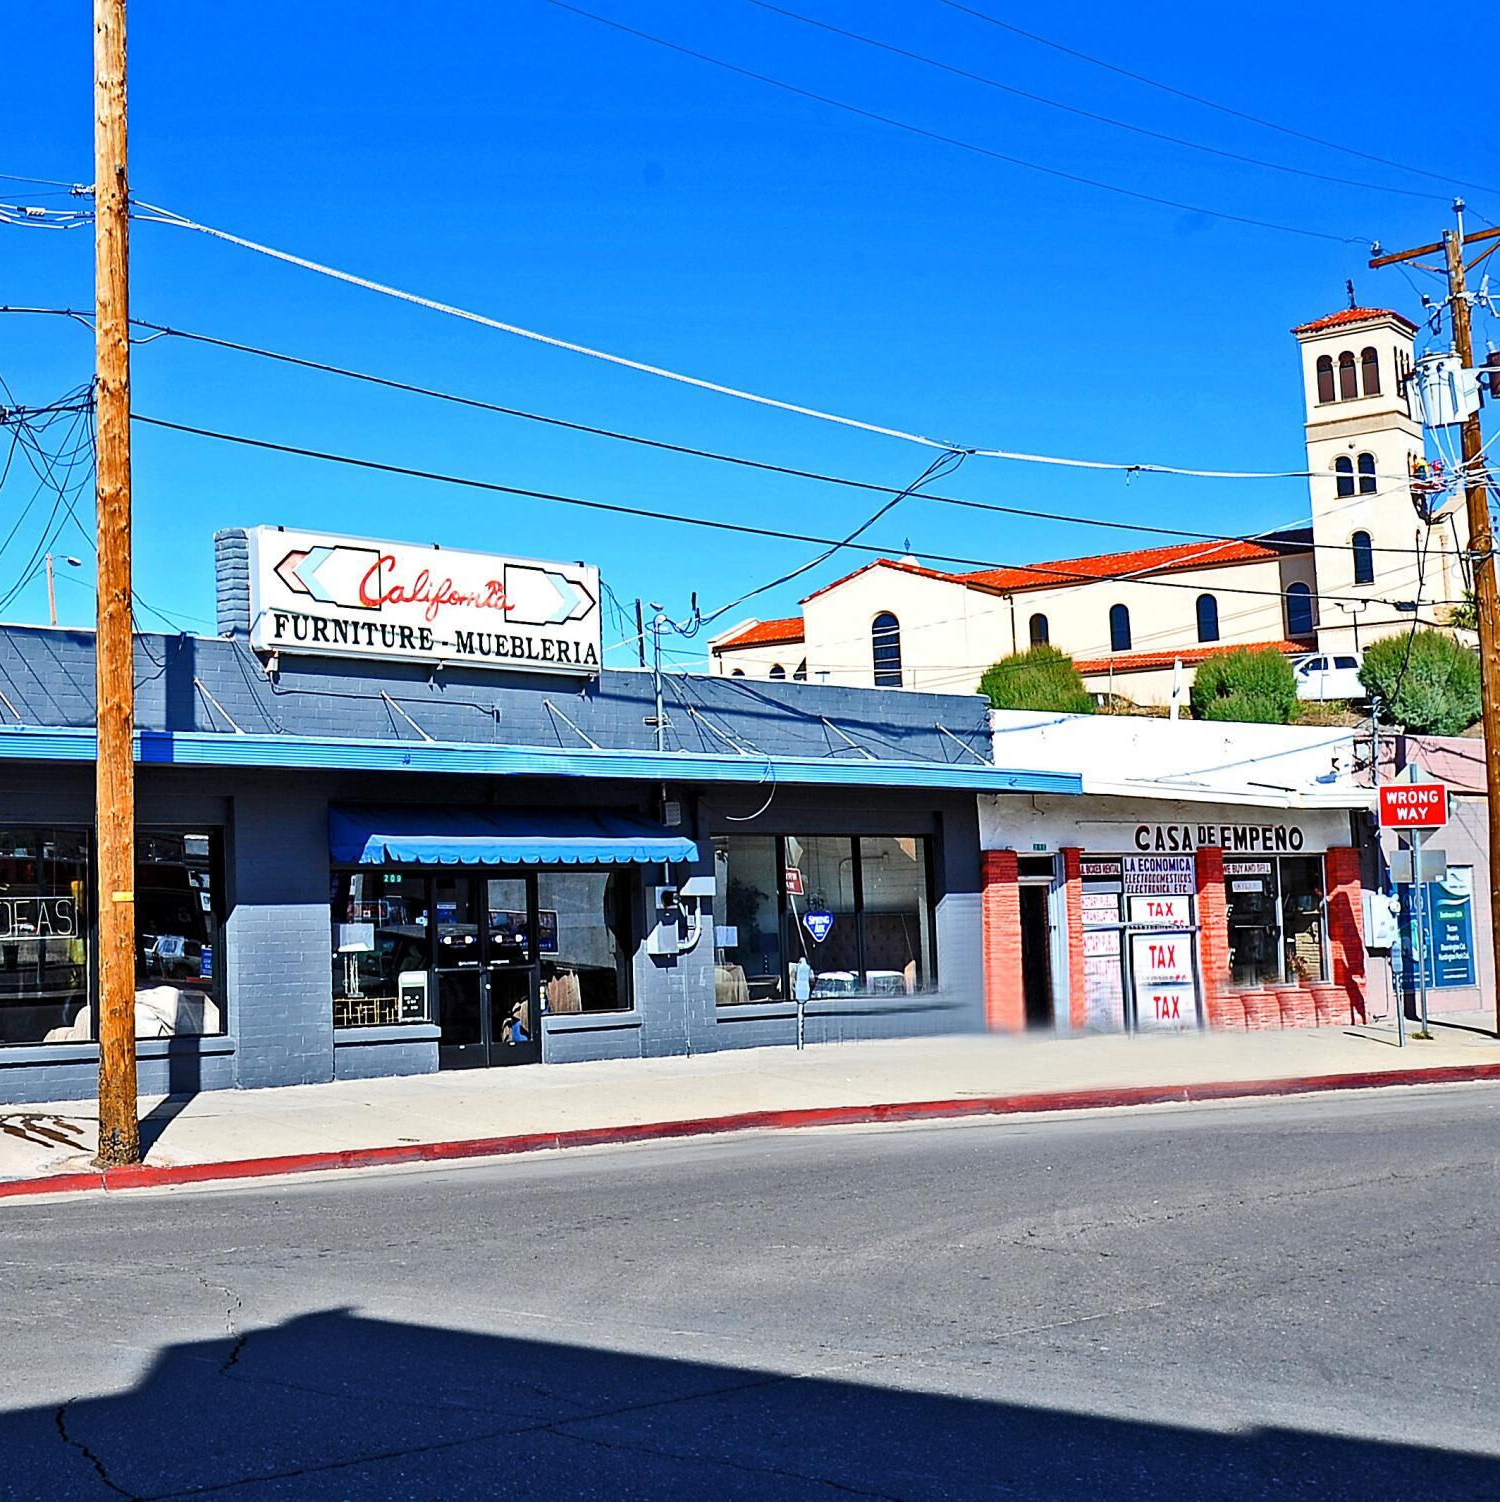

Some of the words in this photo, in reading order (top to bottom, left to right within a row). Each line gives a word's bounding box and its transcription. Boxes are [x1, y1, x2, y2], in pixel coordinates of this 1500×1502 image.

[359, 555, 515, 622] California
[274, 613, 434, 652] FURNITURE
[455, 630, 600, 666] MUEBLERIA
[1386, 790, 1439, 805] WRONG
[1397, 807, 1428, 821] WAY
[1135, 826, 1193, 851] CASA
[1198, 826, 1215, 844] DE
[1220, 825, 1304, 851] EMPEÑO
[1124, 858, 1137, 873] LA
[1139, 857, 1191, 872] ECONOMICA
[1232, 865, 1243, 874] BUY
[1244, 864, 1256, 873] AND
[1124, 873, 1192, 884] ELECTRODOMESTICOS
[1147, 902, 1174, 917] TAX
[1149, 945, 1176, 968] TAX
[1153, 996, 1180, 1019] TAX
